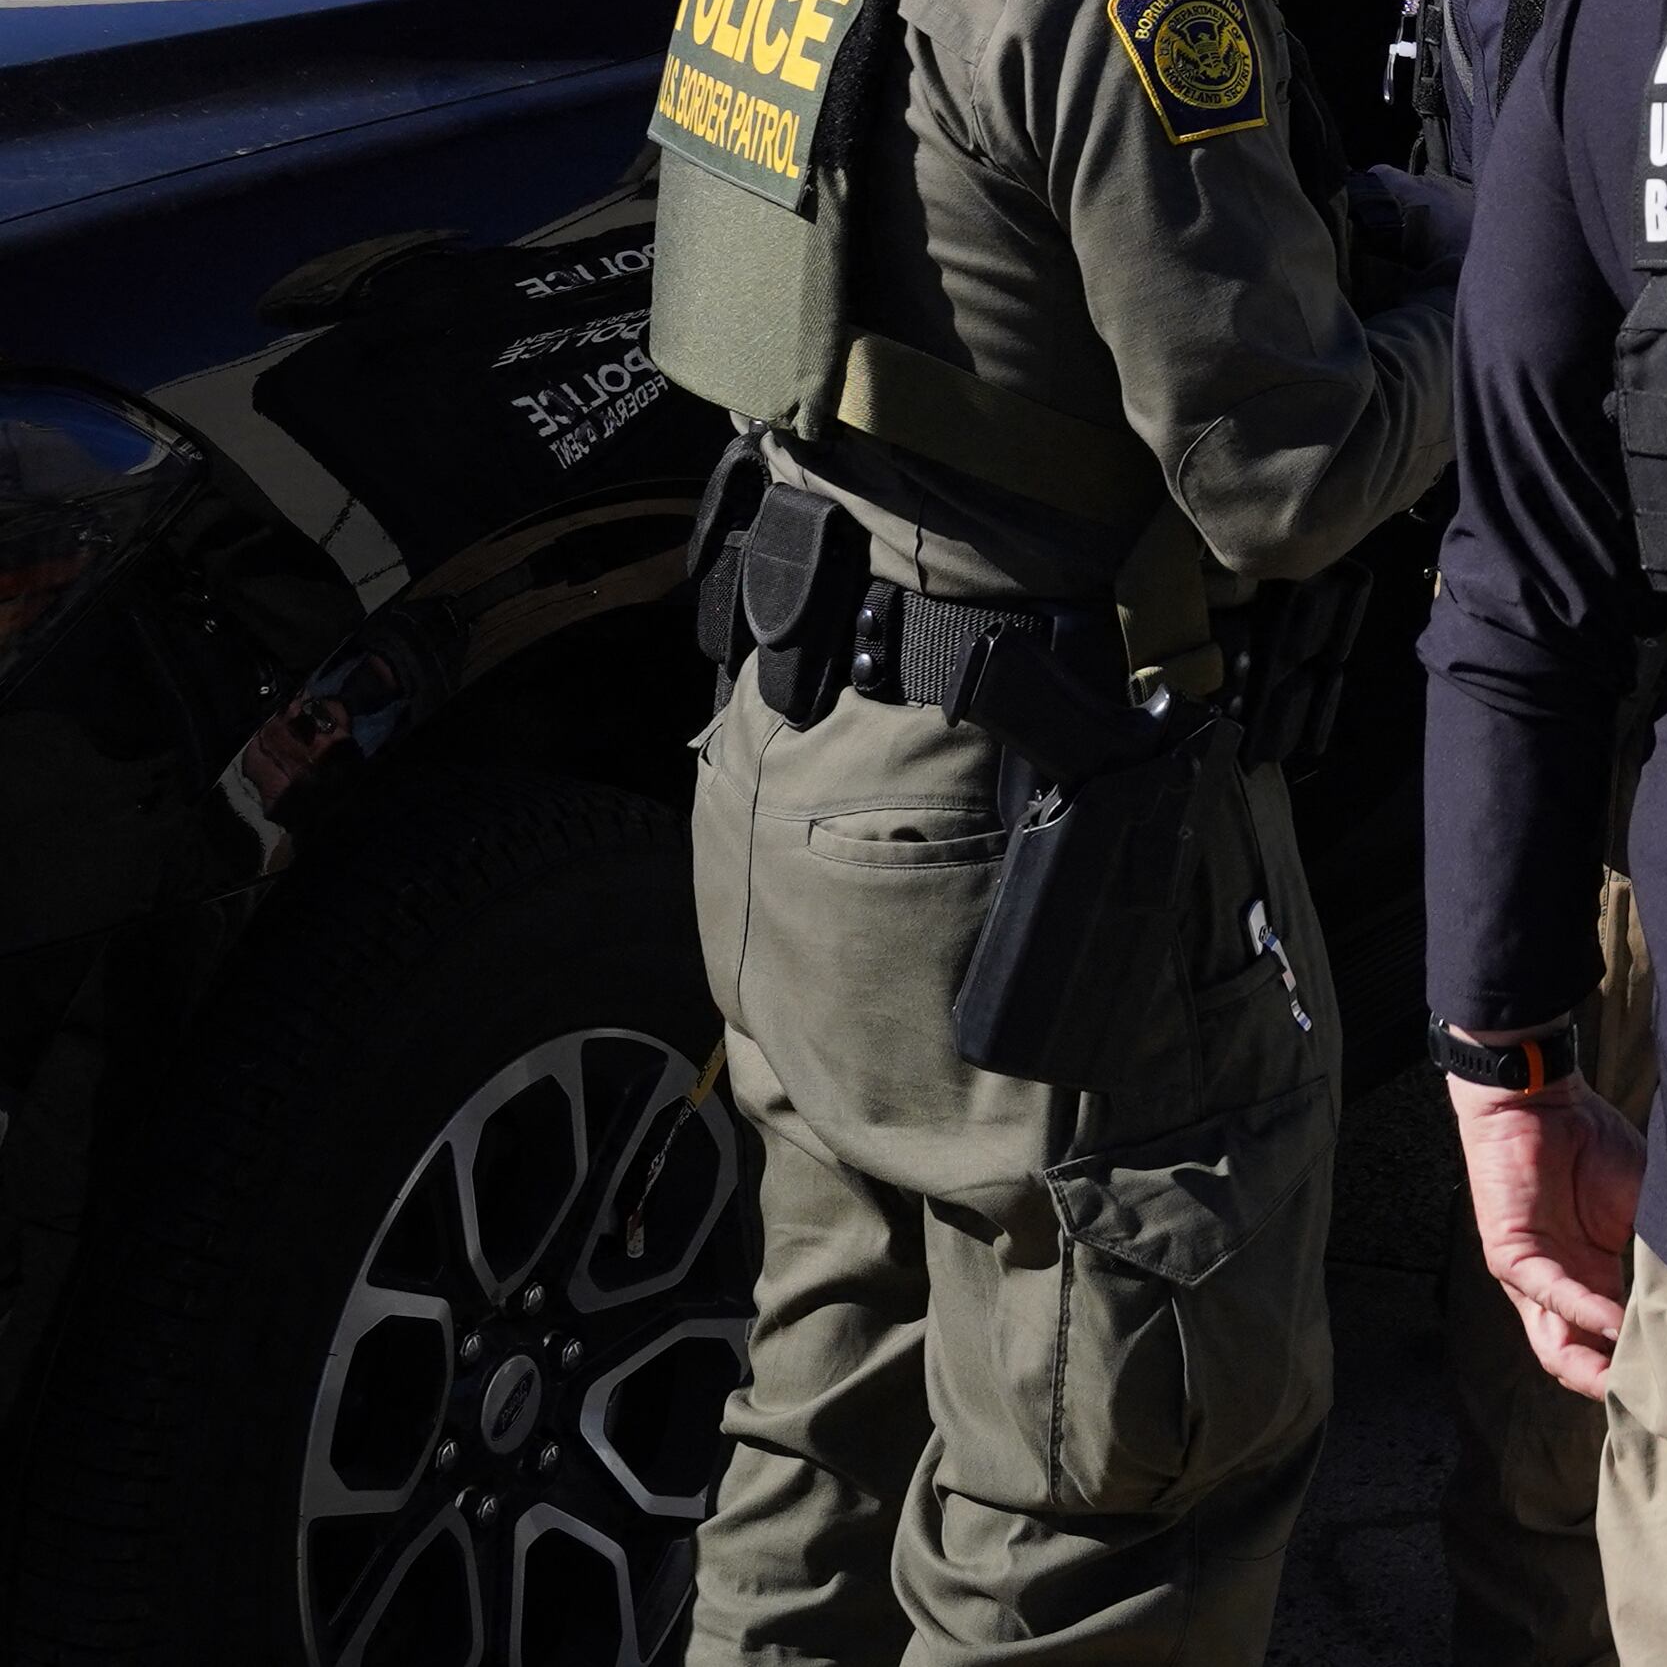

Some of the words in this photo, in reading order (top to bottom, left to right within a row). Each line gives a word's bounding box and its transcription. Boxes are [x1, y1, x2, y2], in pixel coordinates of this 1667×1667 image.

[1167, 5, 1233, 31] DEPARTMENT
[1224, 53, 1250, 103] SECURITY
[675, 64, 734, 151] BORDER
[727, 91, 800, 179] PATROL
